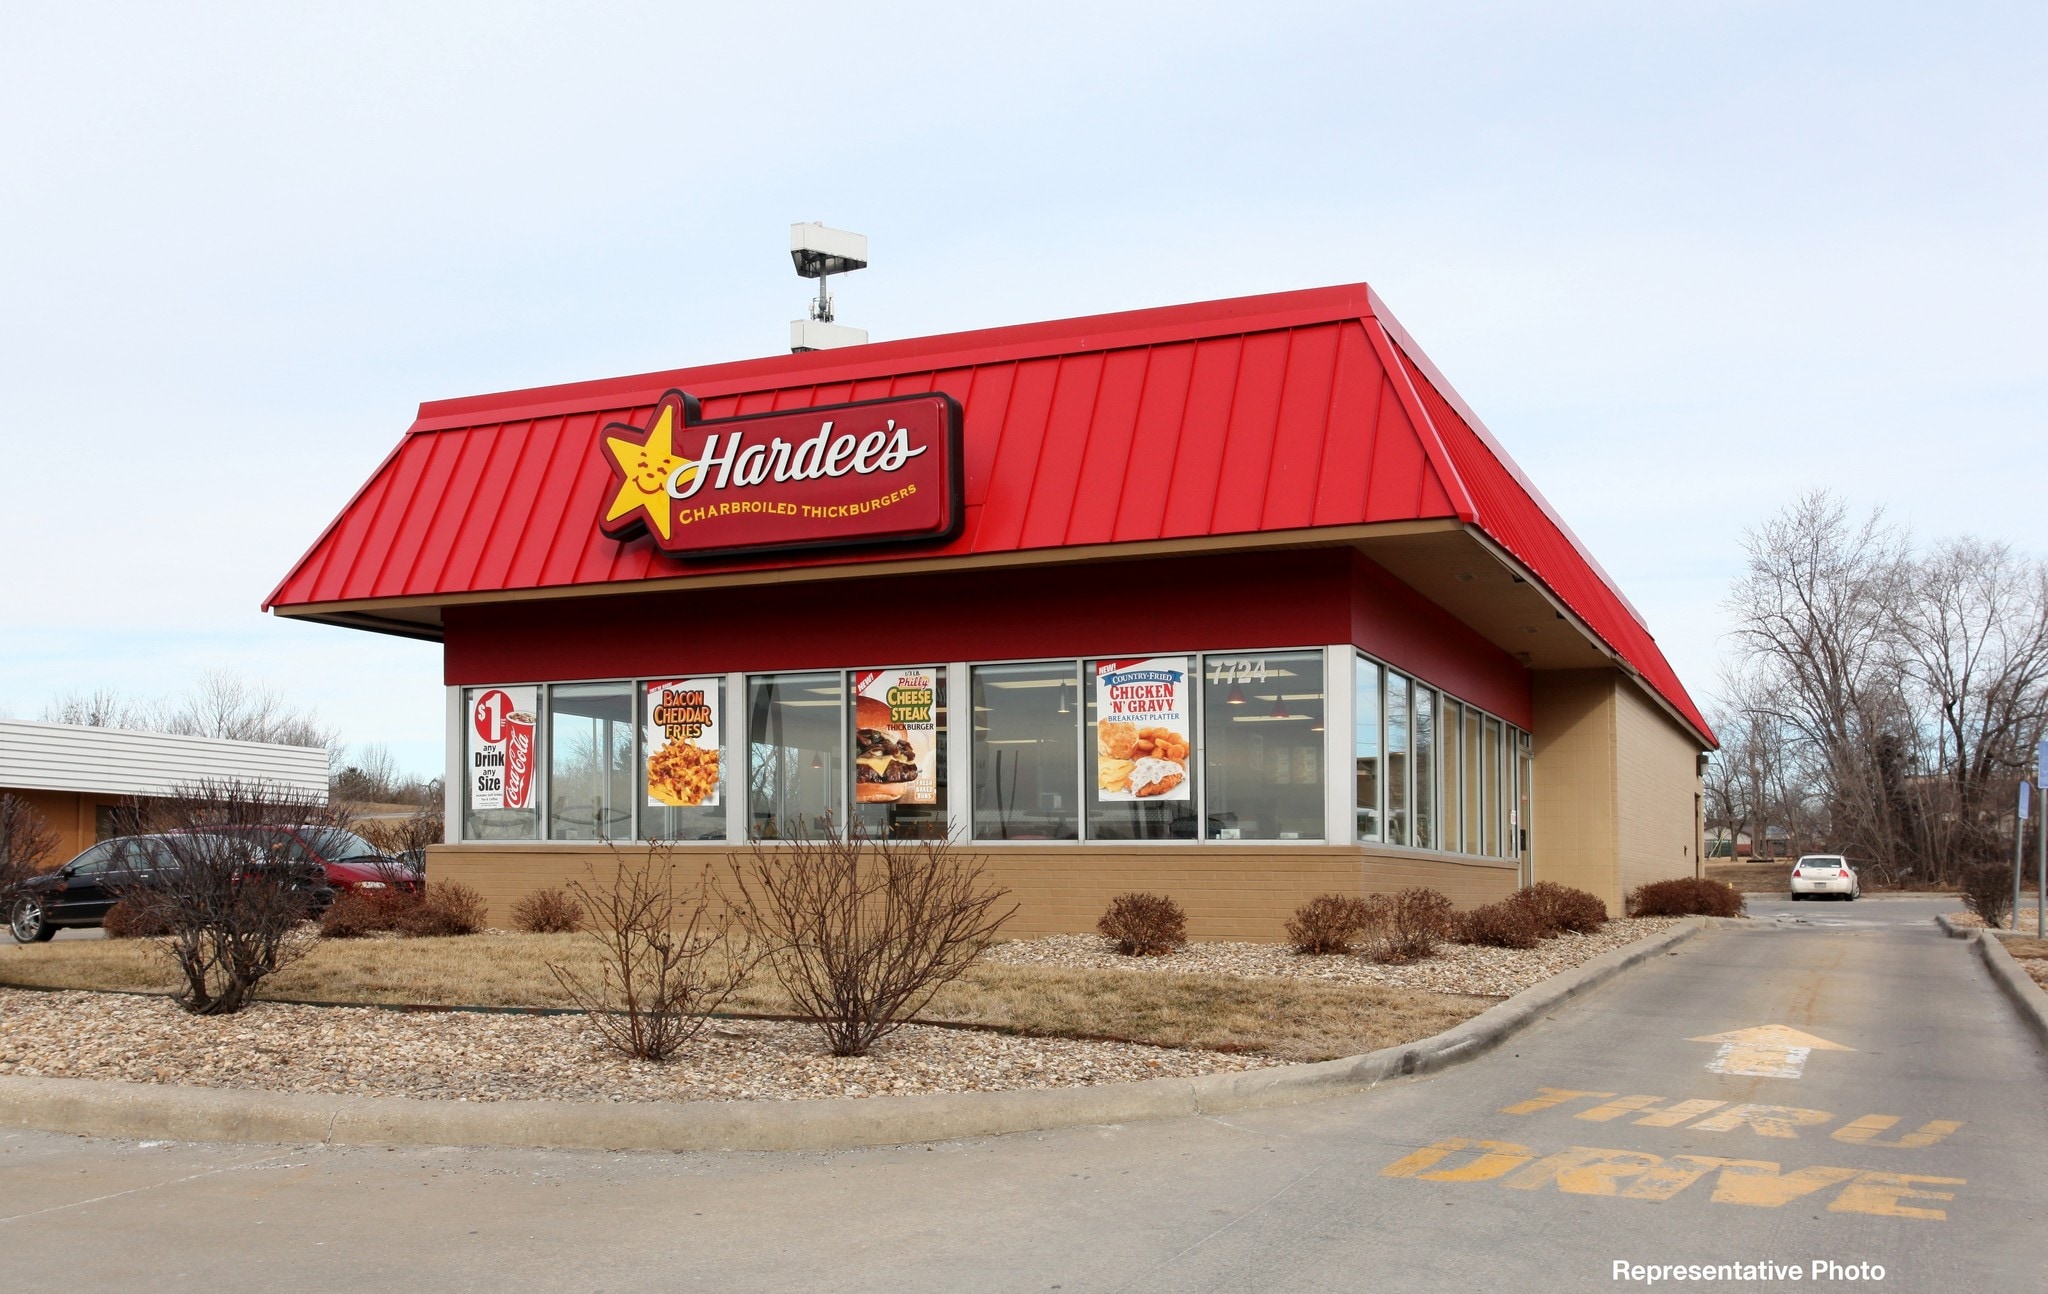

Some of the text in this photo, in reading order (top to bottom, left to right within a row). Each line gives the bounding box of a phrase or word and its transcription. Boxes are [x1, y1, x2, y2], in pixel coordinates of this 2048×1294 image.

[666, 419, 927, 499] Hardee's
[679, 484, 917, 525] CHARBROILED THICKBURGERS
[1098, 663, 1116, 675] NEW!
[1210, 659, 1266, 685] 7724
[857, 673, 875, 692] NEW!
[898, 677, 929, 690] Philly
[663, 690, 704, 707] BACON
[887, 687, 932, 706] CHEESE
[1109, 683, 1174, 700] CHICKEN
[891, 706, 930, 721] STEAK
[1127, 699, 1174, 713] GRAVY
[654, 705, 713, 727] CHEDDAR
[1108, 713, 1180, 722] BREAKFAST PLATTER
[666, 724, 702, 739] FRIES
[887, 723, 934, 731] THICKBURGER
[475, 751, 505, 768] Drink
[478, 776, 501, 792] Size
[1502, 1087, 1969, 1149] THRU
[1379, 1136, 1968, 1221] DRIVE
